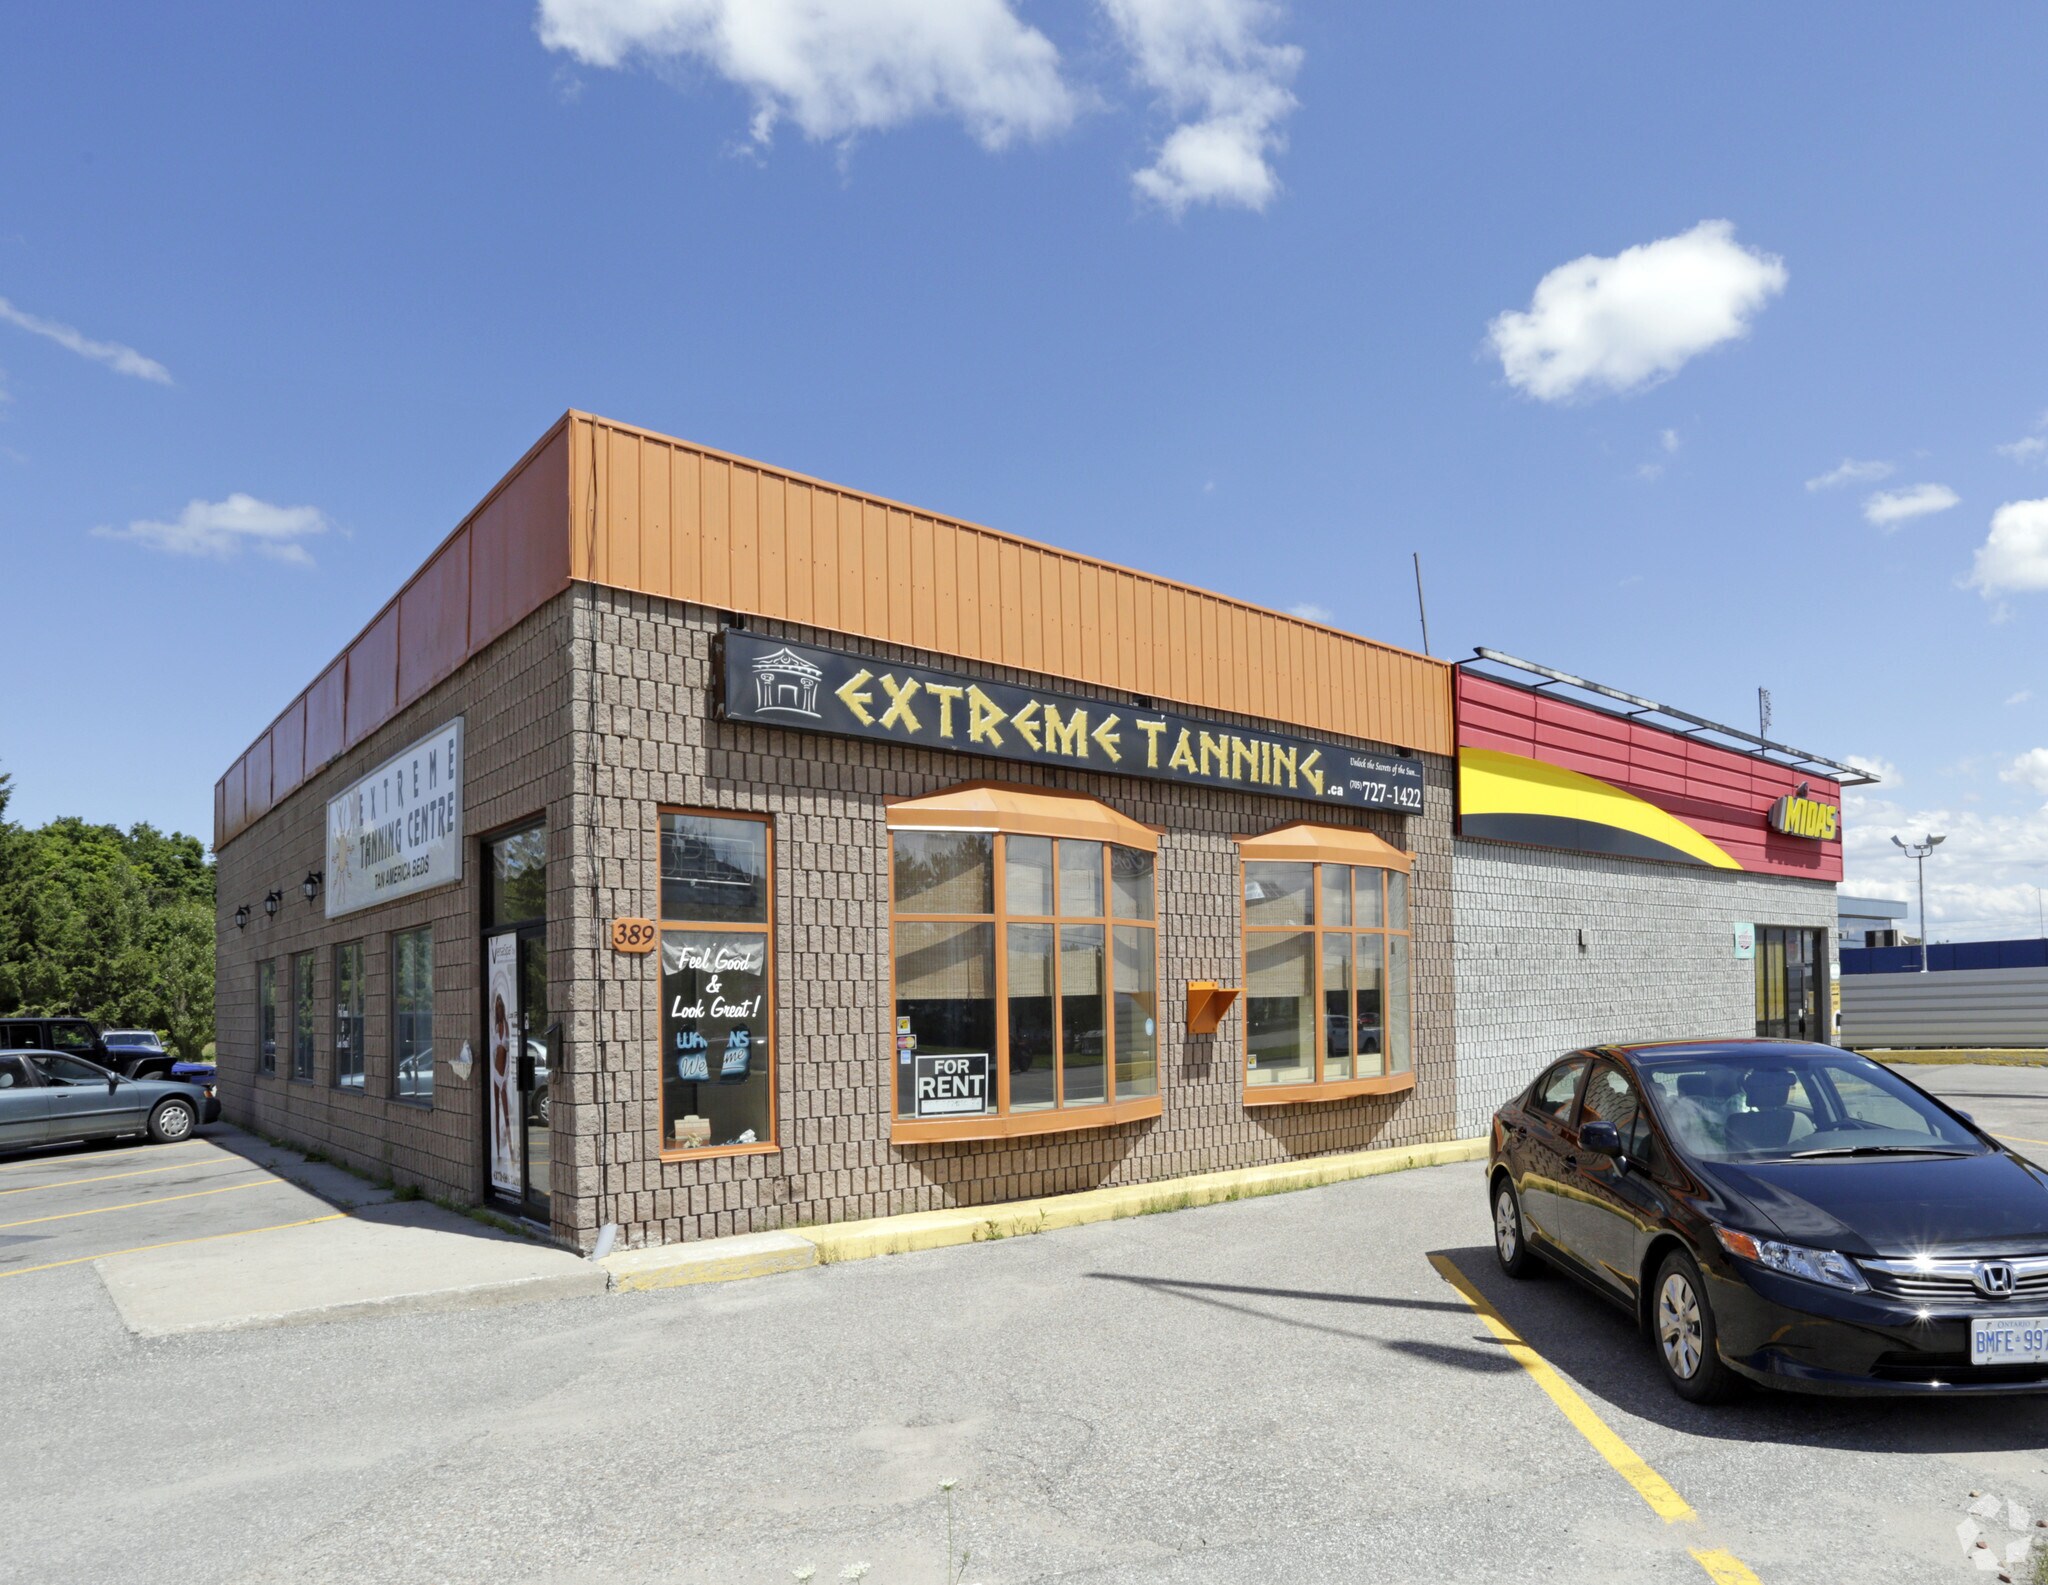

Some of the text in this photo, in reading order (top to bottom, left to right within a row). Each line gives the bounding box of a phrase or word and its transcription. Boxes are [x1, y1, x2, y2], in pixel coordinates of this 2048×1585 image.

[835, 668, 1344, 797] EXTREME TANNING .ca
[1350, 757, 1366, 769] Unlock
[1367, 760, 1375, 770] the
[1375, 762, 1391, 773] Secrets
[1392, 764, 1398, 776] of
[1398, 765, 1406, 775] the
[359, 739, 455, 826] EXTREME
[1350, 780, 1421, 808] (705) 727-1422
[1784, 796, 1837, 840] MIDAS
[360, 791, 454, 870] TANNING CENTRE
[375, 854, 429, 890] TAN AMERICA BEDS
[614, 923, 655, 946] 389
[679, 947, 750, 971] Feel Good
[706, 974, 722, 994] &
[671, 996, 705, 1018] Look
[934, 1059, 970, 1075] FOR
[919, 1075, 985, 1099] RENT
